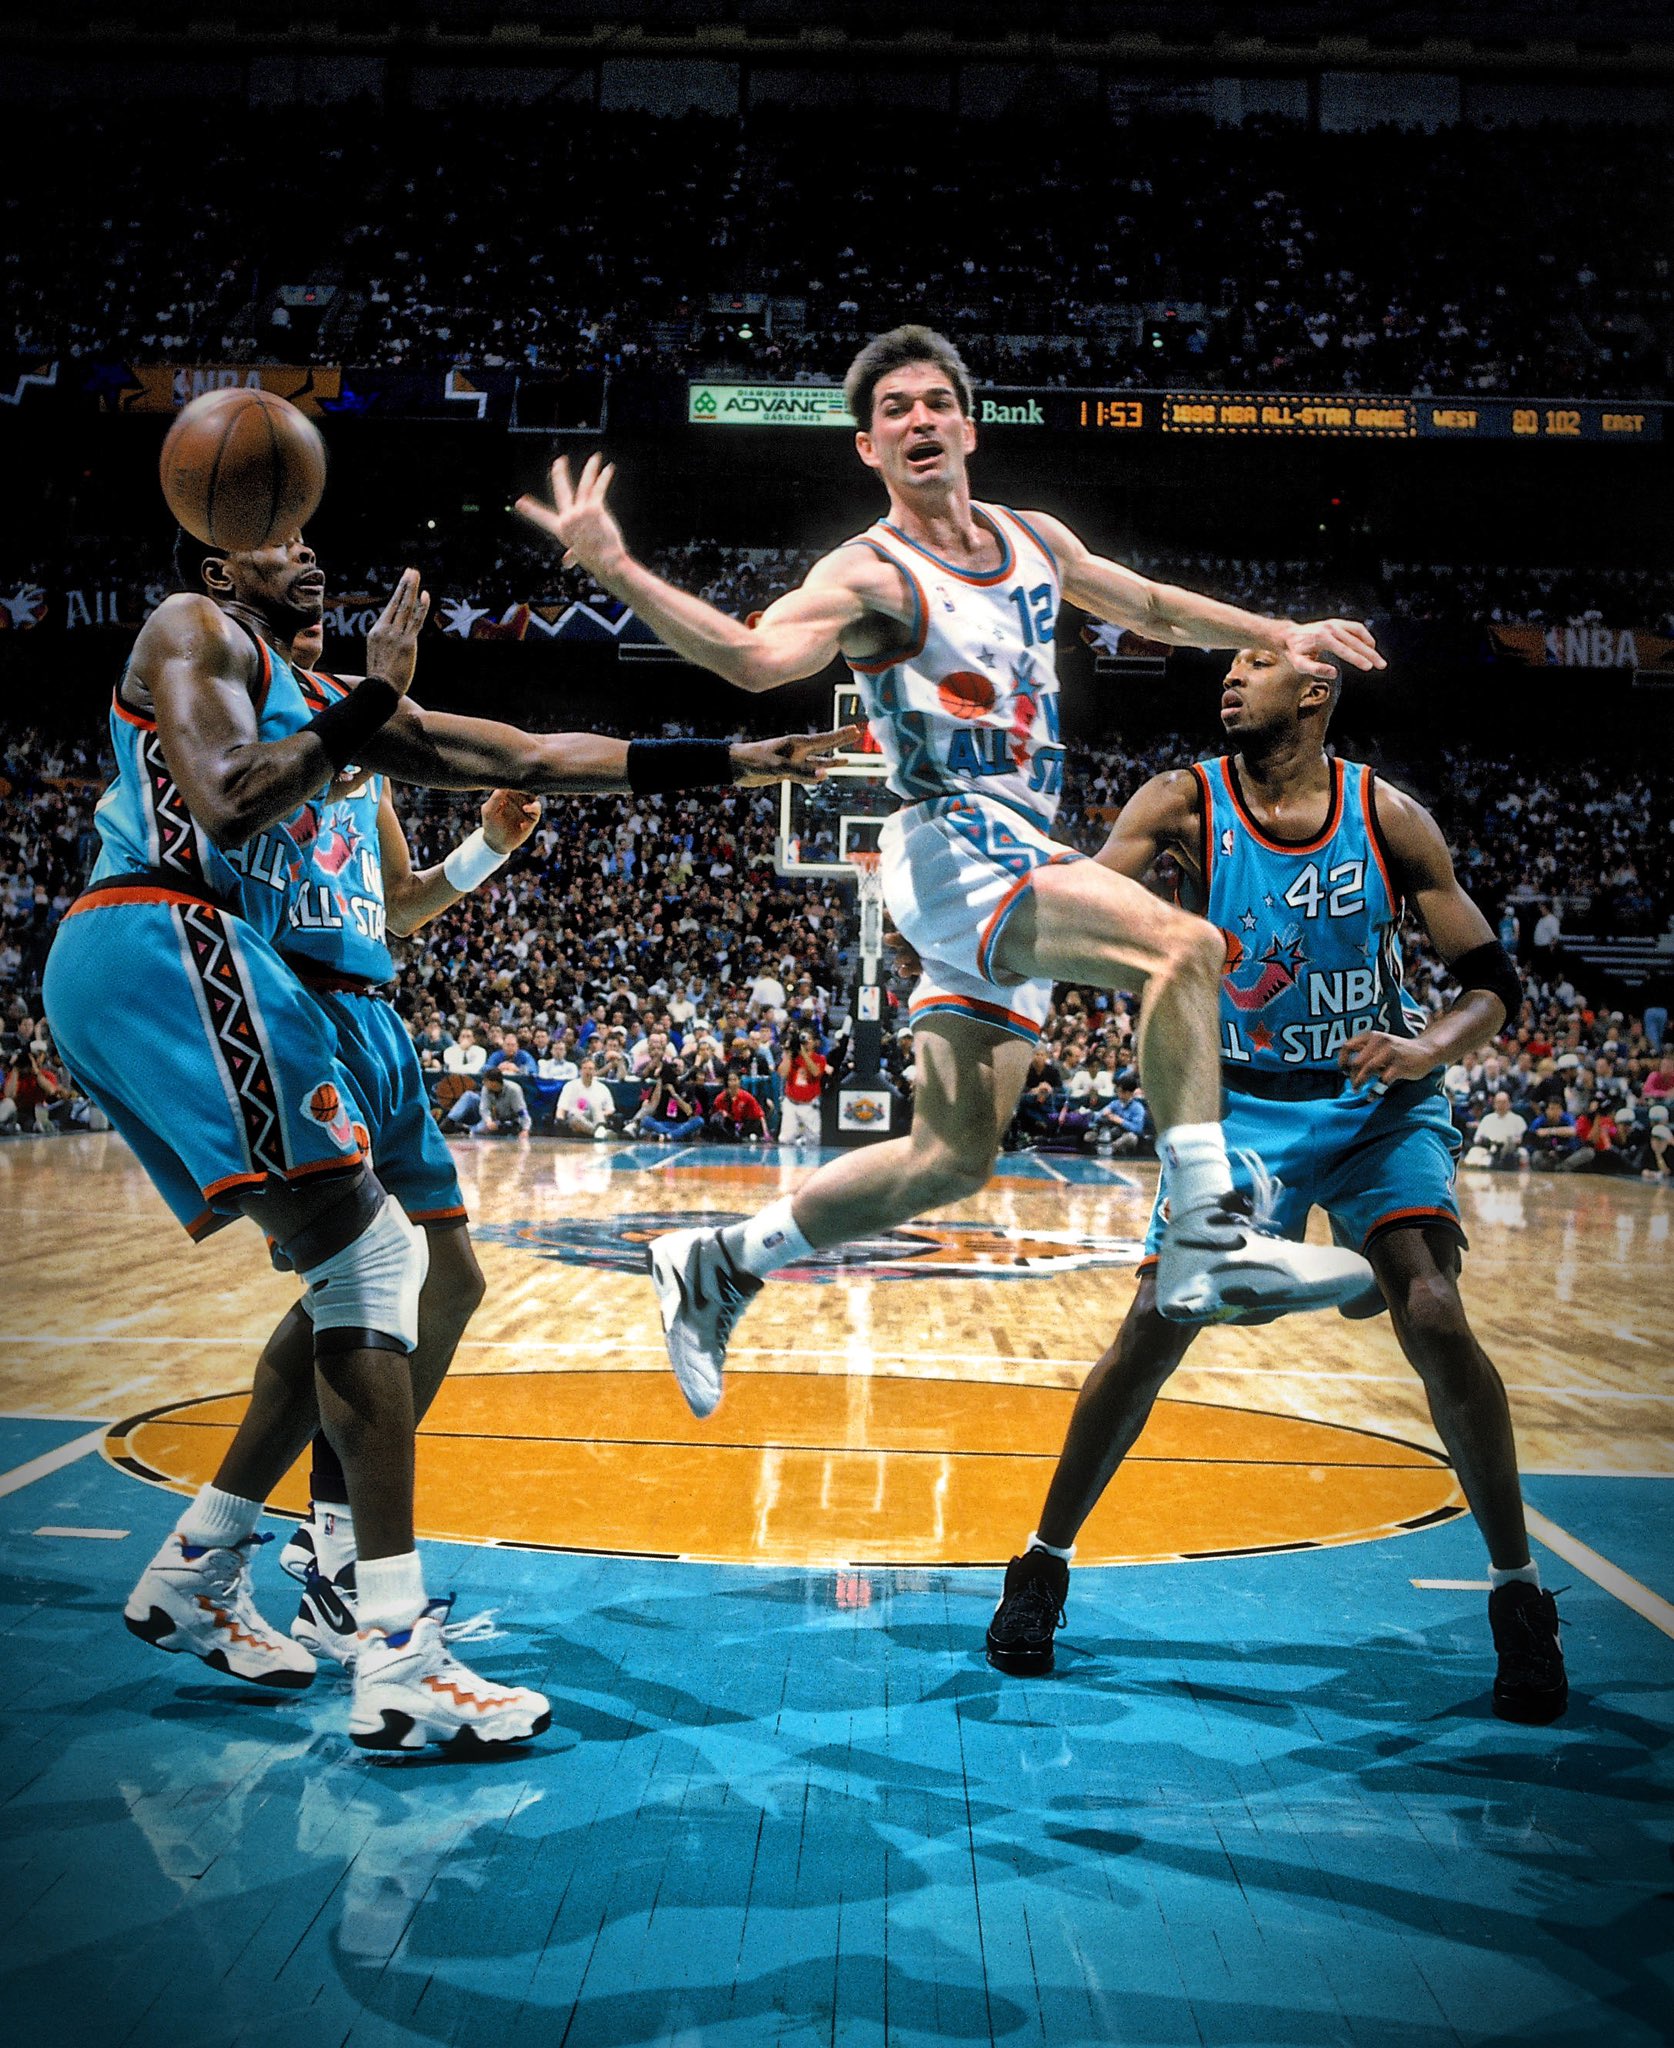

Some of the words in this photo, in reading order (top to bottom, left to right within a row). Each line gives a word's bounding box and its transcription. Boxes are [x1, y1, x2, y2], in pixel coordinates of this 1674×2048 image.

[738, 389, 786, 397] DIAMOND
[763, 413, 821, 422] GASOLINES
[981, 398, 1045, 424] Bank
[1081, 401, 1143, 427] 11:53
[1173, 404, 1216, 424] 1996
[1221, 406, 1258, 425] NBA
[1262, 406, 1351, 426] ALL-STAR
[1355, 408, 1407, 428] GAME
[1432, 409, 1479, 429] WEST
[1545, 410, 1581, 435] 102
[1602, 413, 1645, 432] EAST
[1009, 583, 1054, 647] 12
[1566, 626, 1639, 668] NBA
[947, 728, 1018, 778] ALL
[1283, 860, 1364, 918] 42
